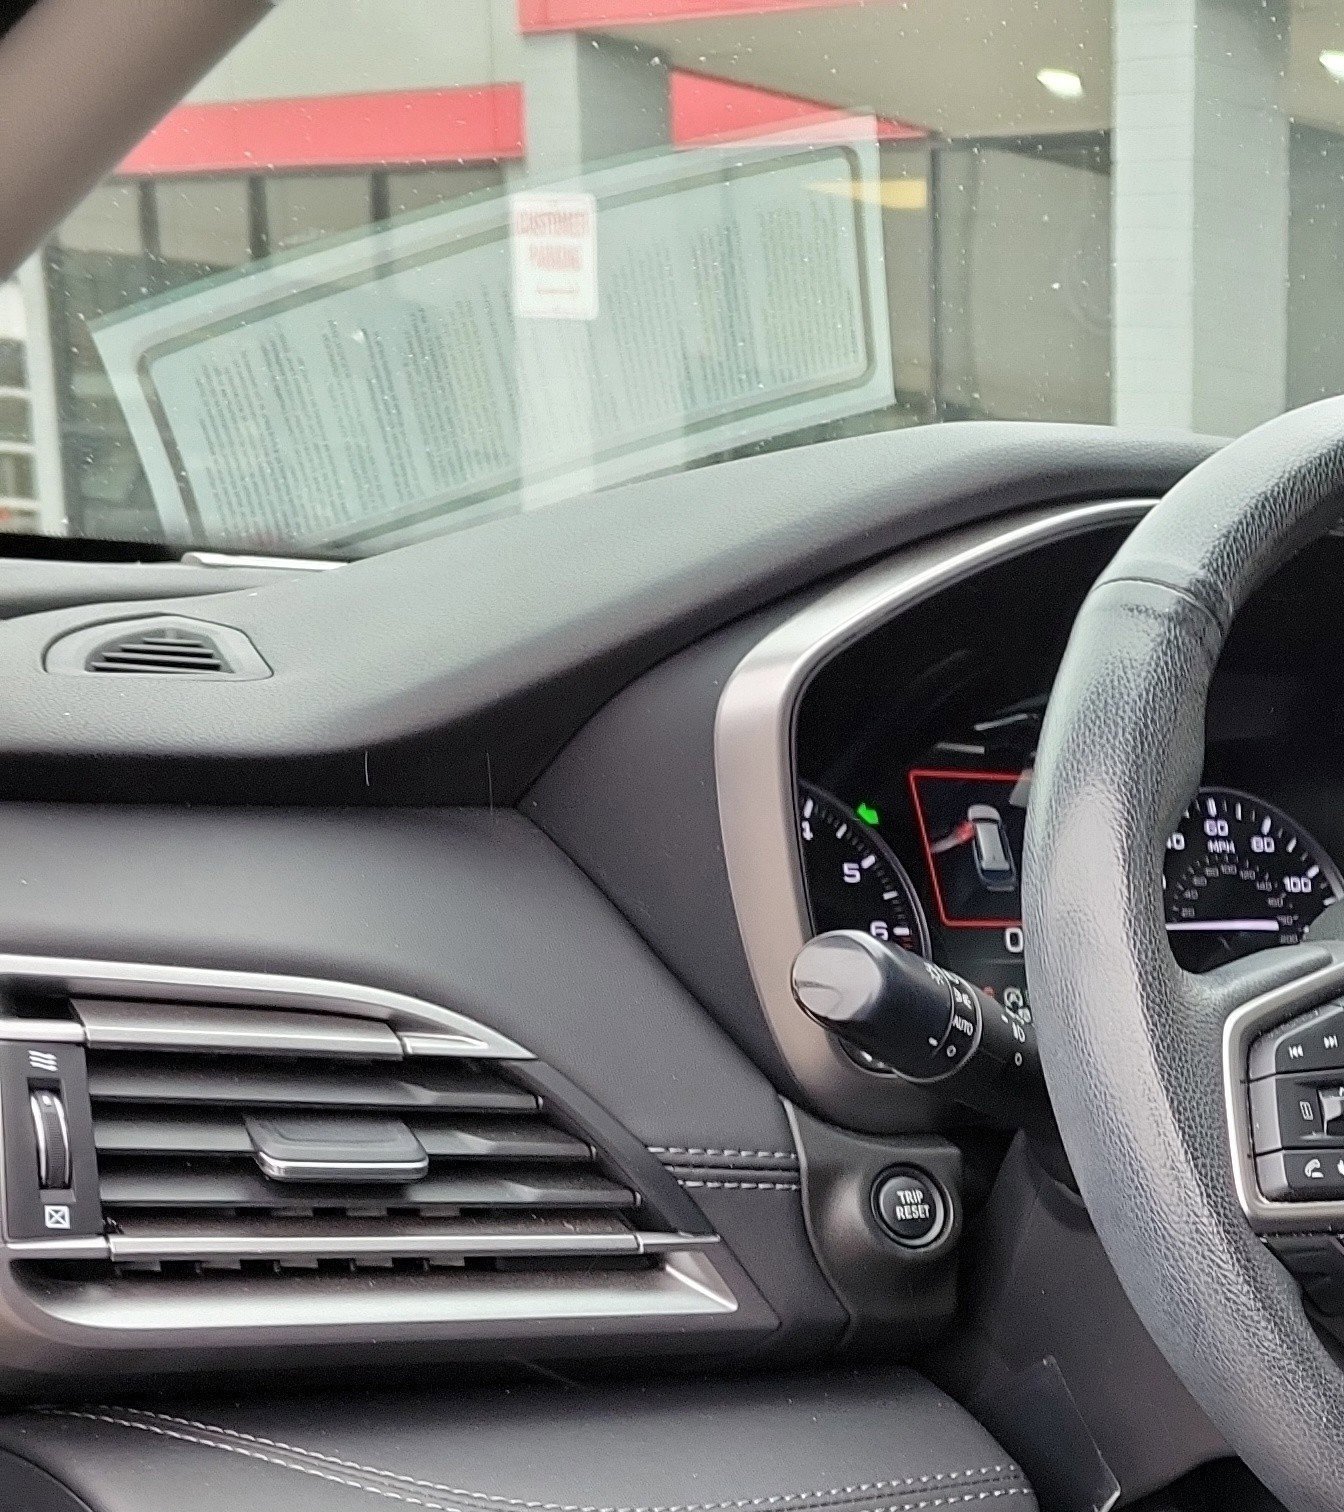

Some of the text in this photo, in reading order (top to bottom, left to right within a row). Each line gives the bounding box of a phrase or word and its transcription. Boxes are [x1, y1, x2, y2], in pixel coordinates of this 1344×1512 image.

[1204, 818, 1229, 838] 60
[1207, 839, 1235, 854] MPH
[1250, 835, 1275, 853] 80
[842, 861, 861, 883] 5
[1282, 875, 1312, 894] 100
[870, 920, 889, 941] 6
[1004, 926, 1024, 954] 0
[953, 1014, 974, 1037] AUTO
[896, 1190, 924, 1205] TRIP
[895, 1204, 930, 1221] RESET
